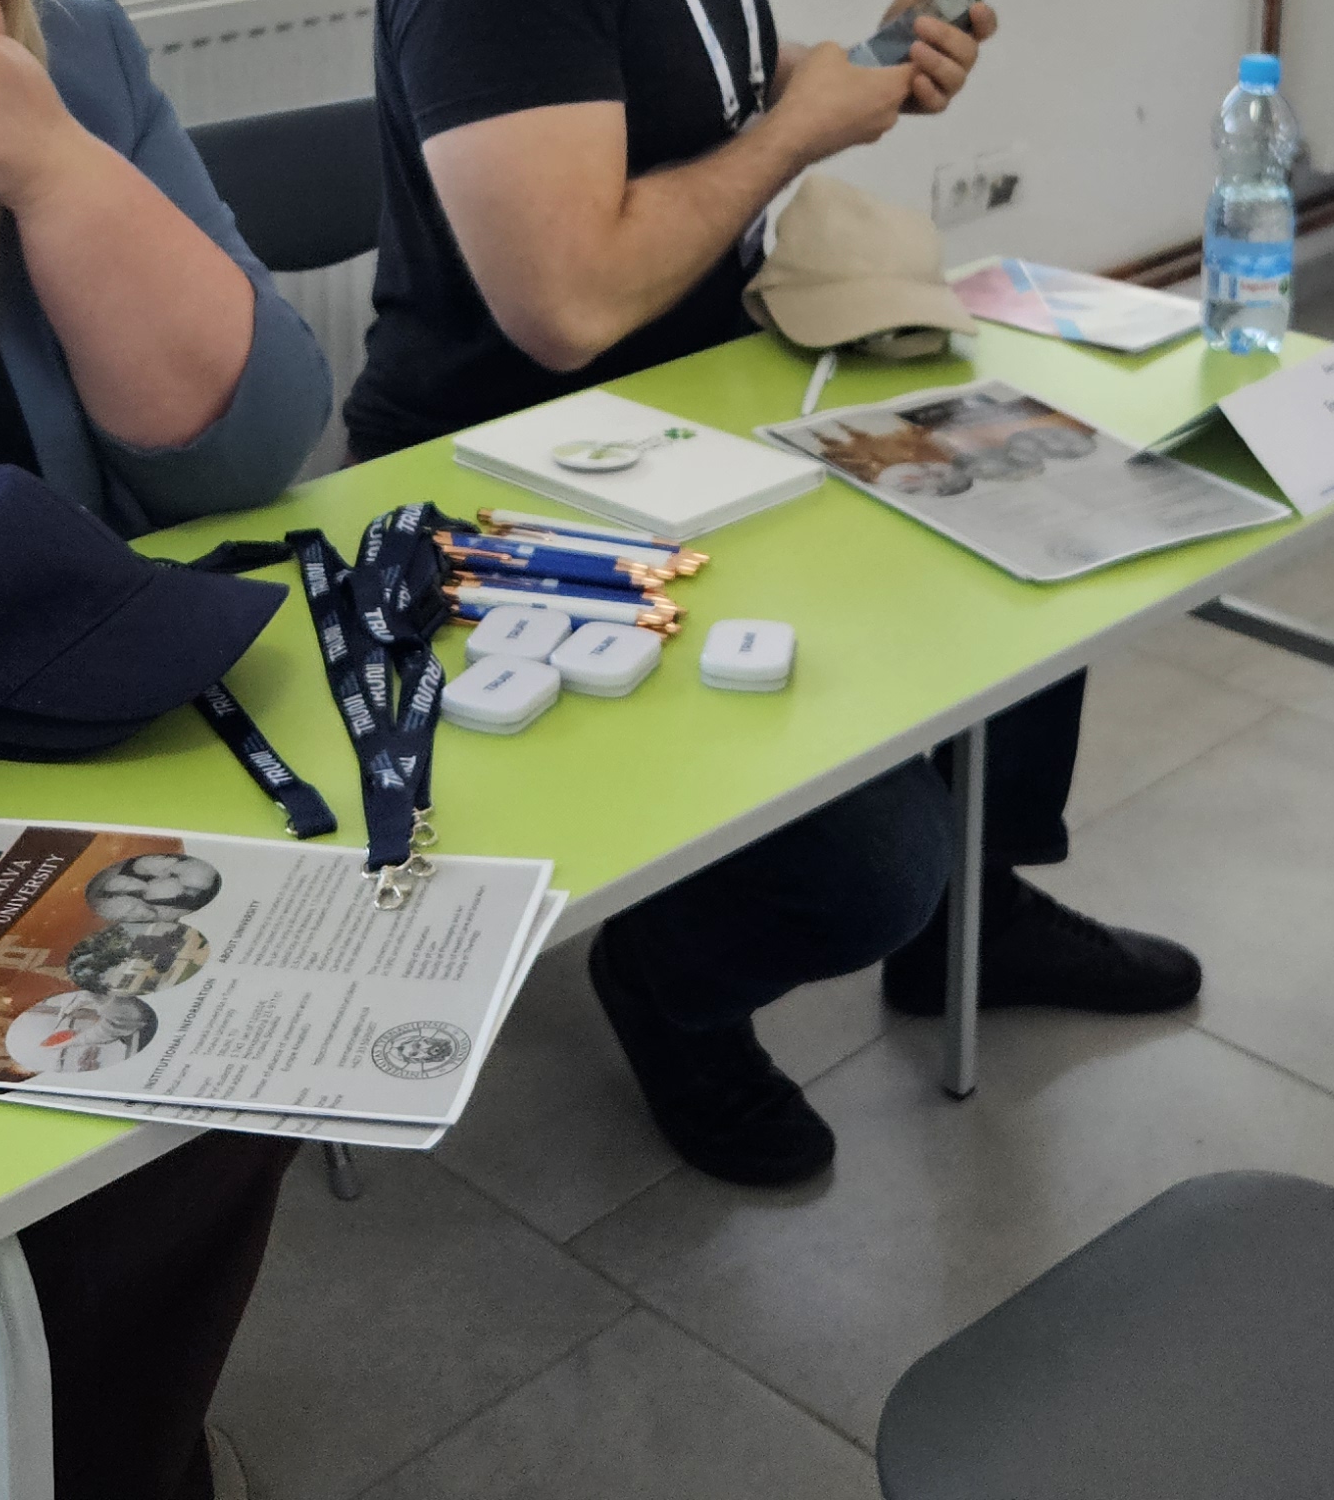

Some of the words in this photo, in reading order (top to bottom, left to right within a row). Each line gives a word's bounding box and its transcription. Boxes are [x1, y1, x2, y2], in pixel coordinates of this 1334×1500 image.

[344, 692, 376, 736] TRUNI
[248, 749, 294, 787] TRUNI
[219, 939, 238, 964] ABOUT
[236, 899, 261, 940] UNIVERSITY
[144, 1028, 186, 1090] INSTITUTIONAL
[179, 977, 216, 1033] INFORMATION
